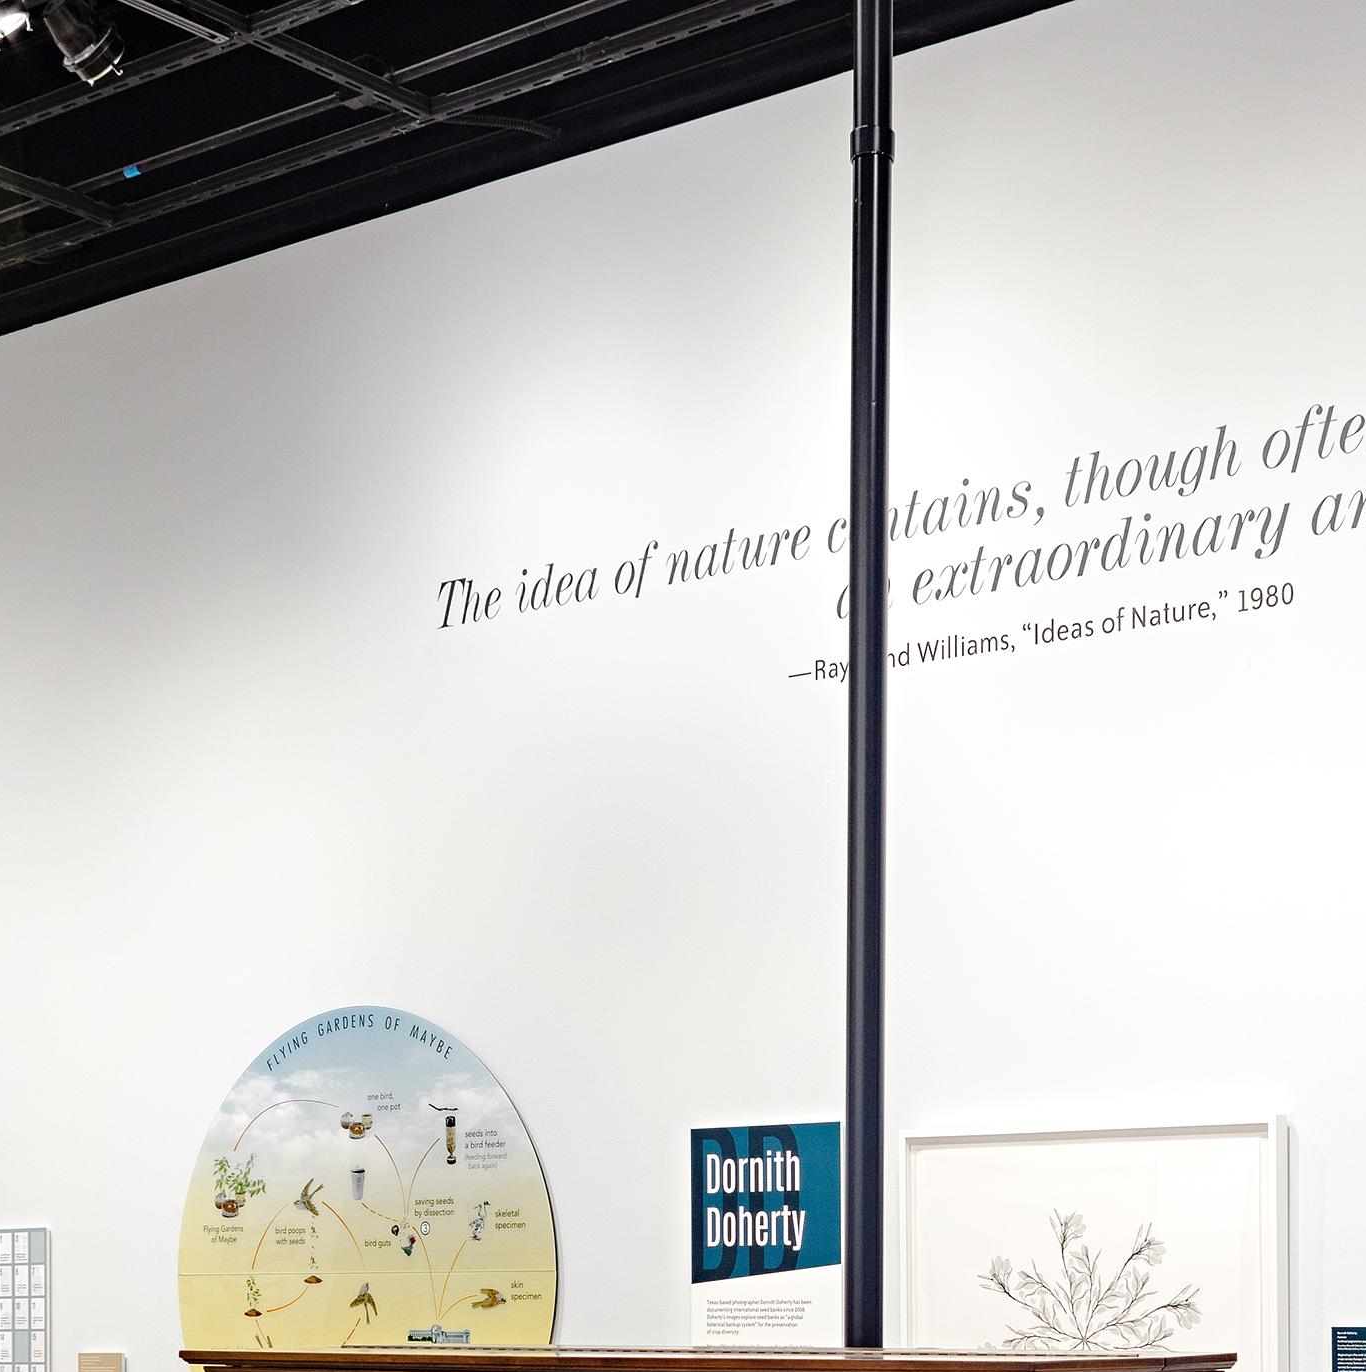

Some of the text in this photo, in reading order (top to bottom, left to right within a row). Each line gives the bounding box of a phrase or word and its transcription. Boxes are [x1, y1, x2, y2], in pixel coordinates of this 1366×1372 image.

[436, 577, 501, 631] The
[516, 563, 598, 615] idea
[614, 540, 660, 598] of
[667, 525, 811, 586] nature
[828, 478, 1045, 554] cntains,
[1065, 424, 1241, 507] though
[912, 496, 1291, 606] extraordinary
[918, 633, 1016, 665] Williams,
[1022, 617, 1095, 646] “Ideas
[1102, 607, 1126, 634] of
[1132, 589, 1229, 630] Nature,”
[1238, 582, 1294, 613] 1980
[266, 1014, 452, 1071] FLYING GARDENS OF MAYBE
[380, 1093, 394, 1101] bird,
[390, 1104, 401, 1112] pot
[465, 1130, 483, 1138] seeds
[470, 1141, 483, 1149] bird
[485, 1140, 506, 1148] feeder
[706, 1150, 801, 1194] Dornith
[415, 1199, 434, 1207] saving
[415, 1208, 454, 1217] by dissection
[423, 1224, 428, 1232] 3
[495, 1221, 526, 1230] specimen
[706, 1205, 806, 1251] Doherty
[204, 1226, 219, 1235] Flying
[218, 1236, 237, 1244] Maybe
[379, 1240, 391, 1249] guts
[511, 1293, 542, 1301] specimen
